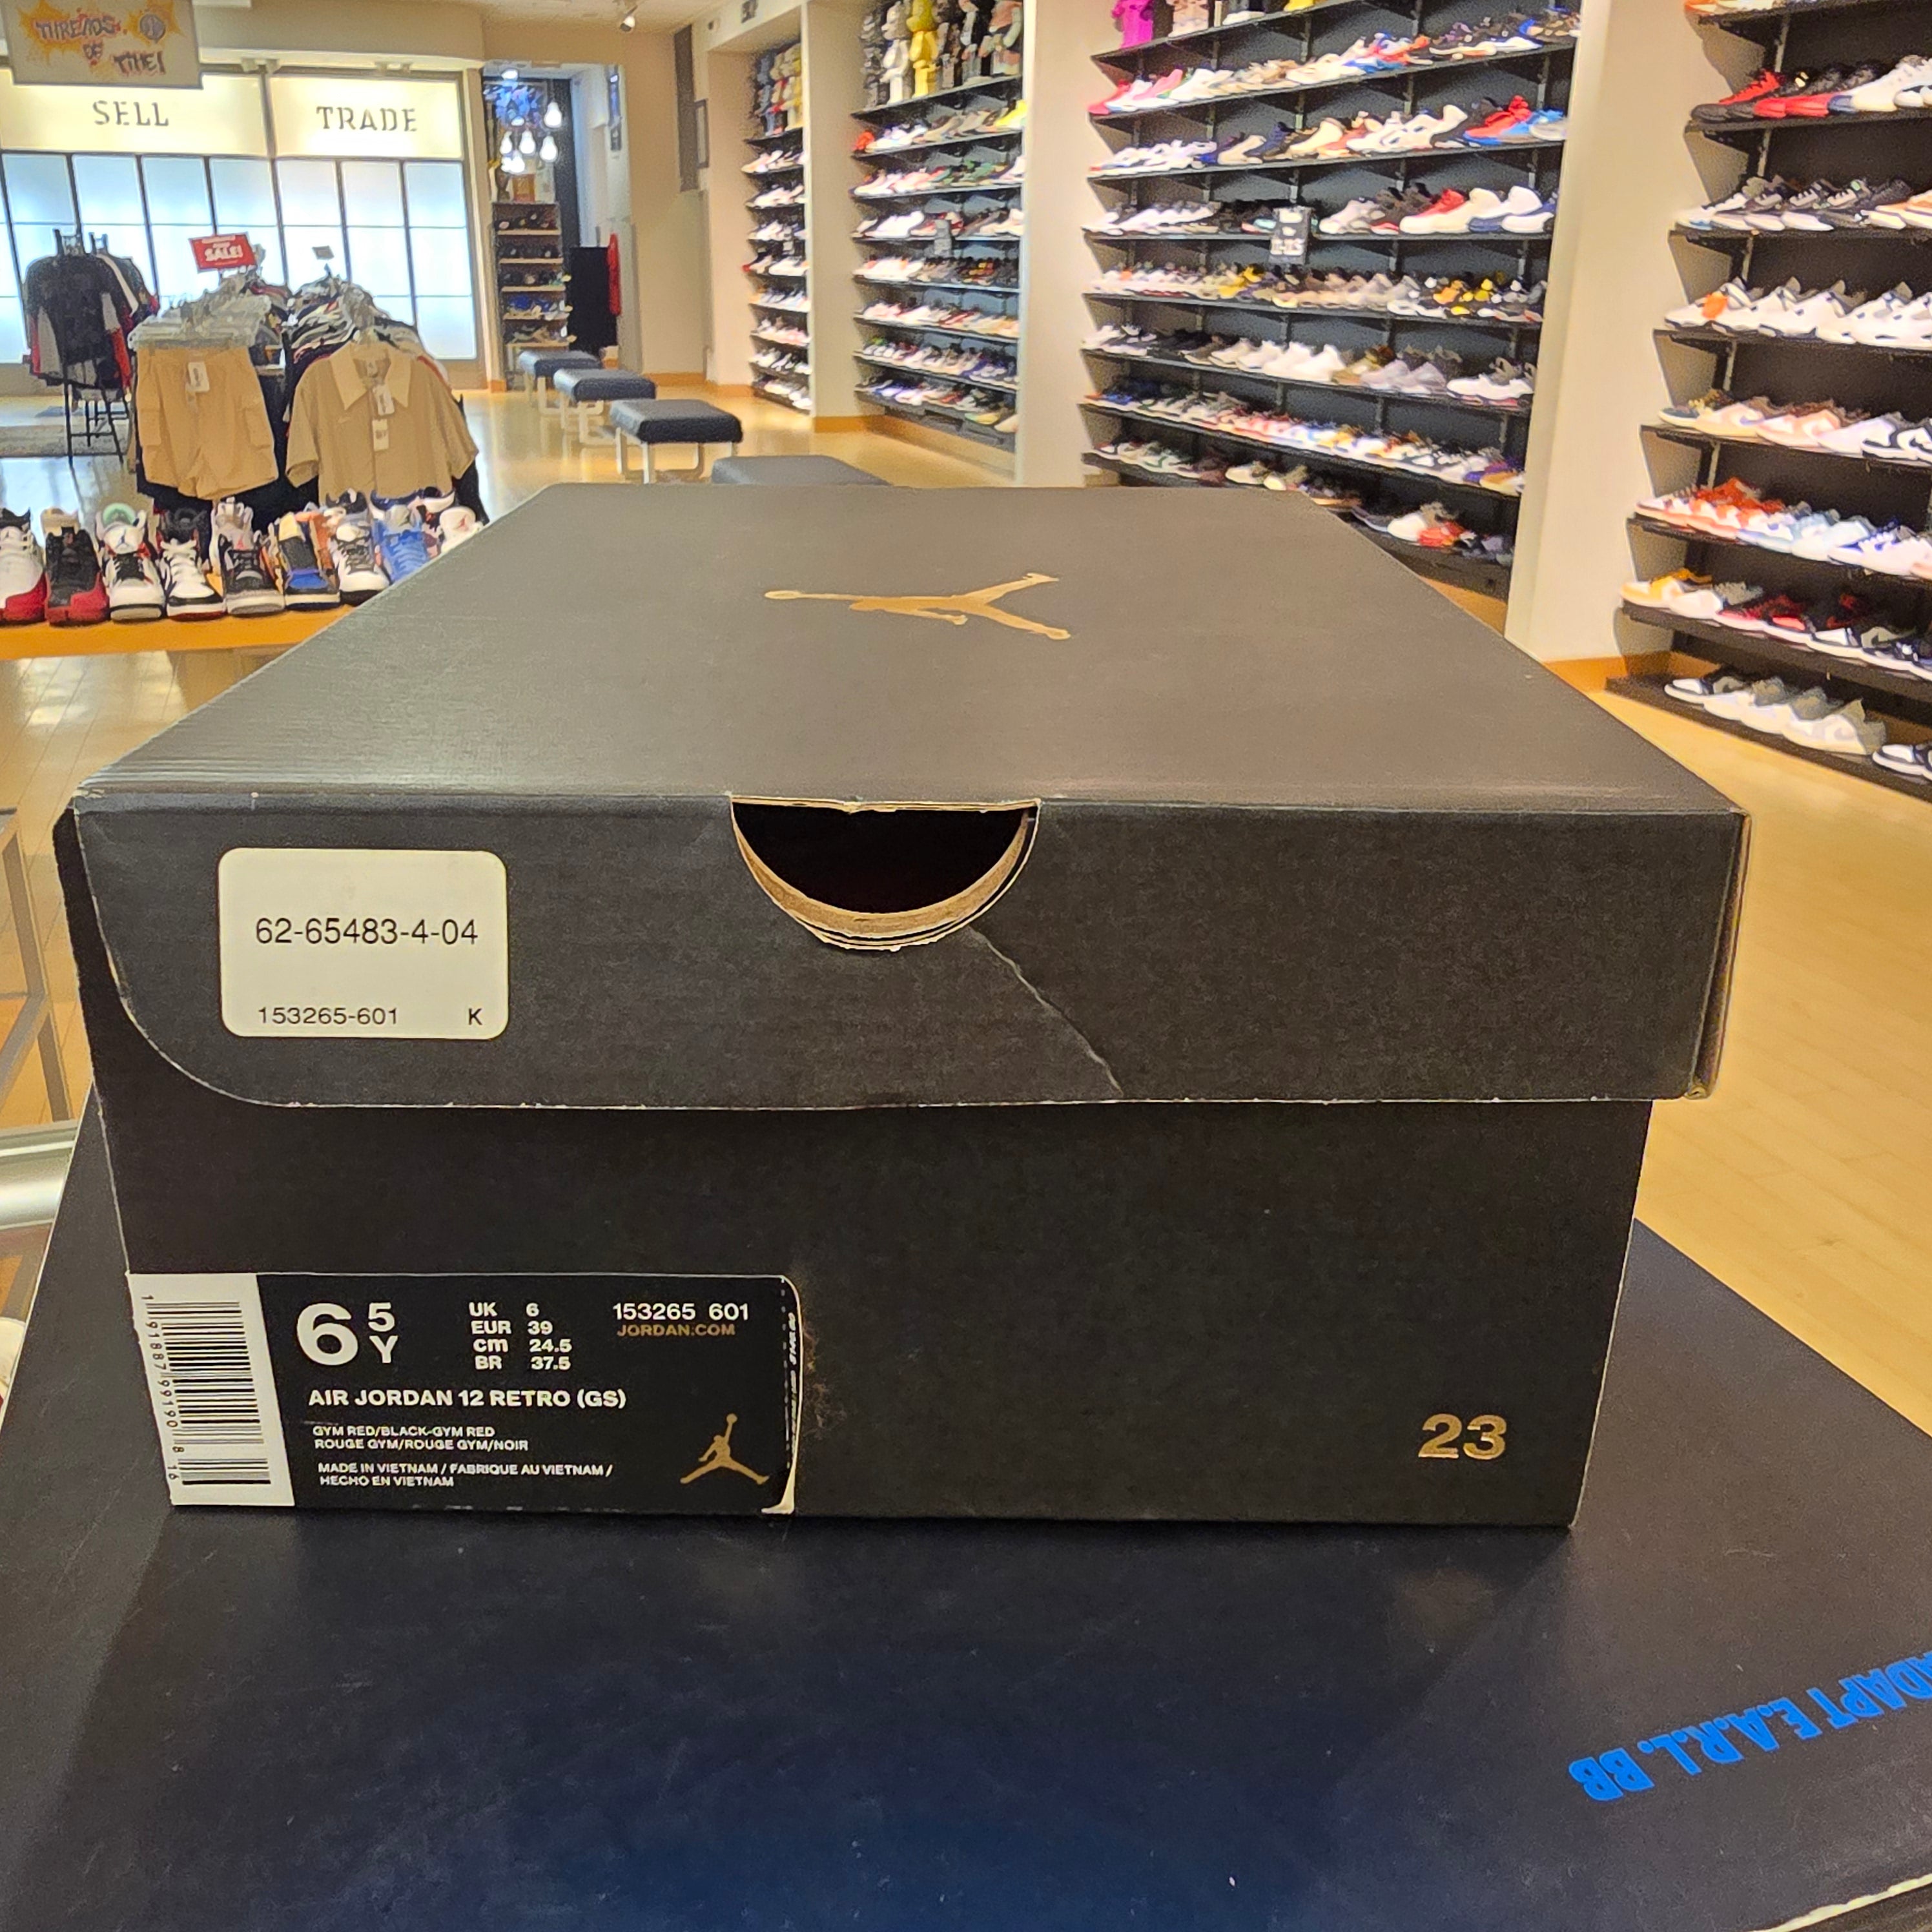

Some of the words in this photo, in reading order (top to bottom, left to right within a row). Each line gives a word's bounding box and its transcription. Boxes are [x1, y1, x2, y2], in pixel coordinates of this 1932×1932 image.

[92, 100, 169, 127] SELL
[316, 107, 417, 132] TRADE
[256, 918, 478, 945] 62-65483-4-04
[258, 1007, 398, 1025] 153265-601
[468, 1008, 482, 1025] K
[367, 1301, 395, 1332] 5
[469, 1302, 497, 1317] UK
[526, 1302, 540, 1317] 6
[613, 1303, 696, 1321] 153265
[709, 1303, 749, 1321] 601
[296, 1302, 359, 1366] 6
[471, 1321, 512, 1335] EUR
[528, 1321, 553, 1335] 39
[617, 1324, 735, 1337] JORDAN.COM
[369, 1335, 398, 1364] Y
[473, 1339, 509, 1353] cm
[529, 1339, 573, 1353] 24.5
[475, 1355, 502, 1370] BR
[531, 1356, 571, 1370] 37.5
[309, 1389, 349, 1406] AIR
[355, 1389, 453, 1406] JORDAN
[458, 1390, 484, 1406] 12
[489, 1390, 571, 1407] RETRO
[577, 1388, 627, 1409] (GS)
[313, 1426, 344, 1437] GYM
[347, 1426, 464, 1437] RED/BLACK-GYM
[466, 1426, 496, 1437] RED
[1418, 1413, 1507, 1460] 23
[314, 1439, 365, 1450] ROUGE
[367, 1439, 455, 1451] GYM/ROUGE
[457, 1439, 529, 1452] GYM/NOIR
[318, 1463, 358, 1474] MADE
[360, 1463, 375, 1474] IN
[376, 1463, 438, 1474] VIETNAM
[449, 1463, 519, 1475] FABRIQUE
[520, 1464, 540, 1475] AU
[542, 1464, 604, 1475] VIETNAM
[320, 1475, 369, 1486] HECHO
[372, 1475, 391, 1486] EN
[393, 1475, 455, 1487] VIETNAM
[1637, 1697, 1823, 1776] E.A.R.L.
[1568, 1747, 1655, 1802] BB
